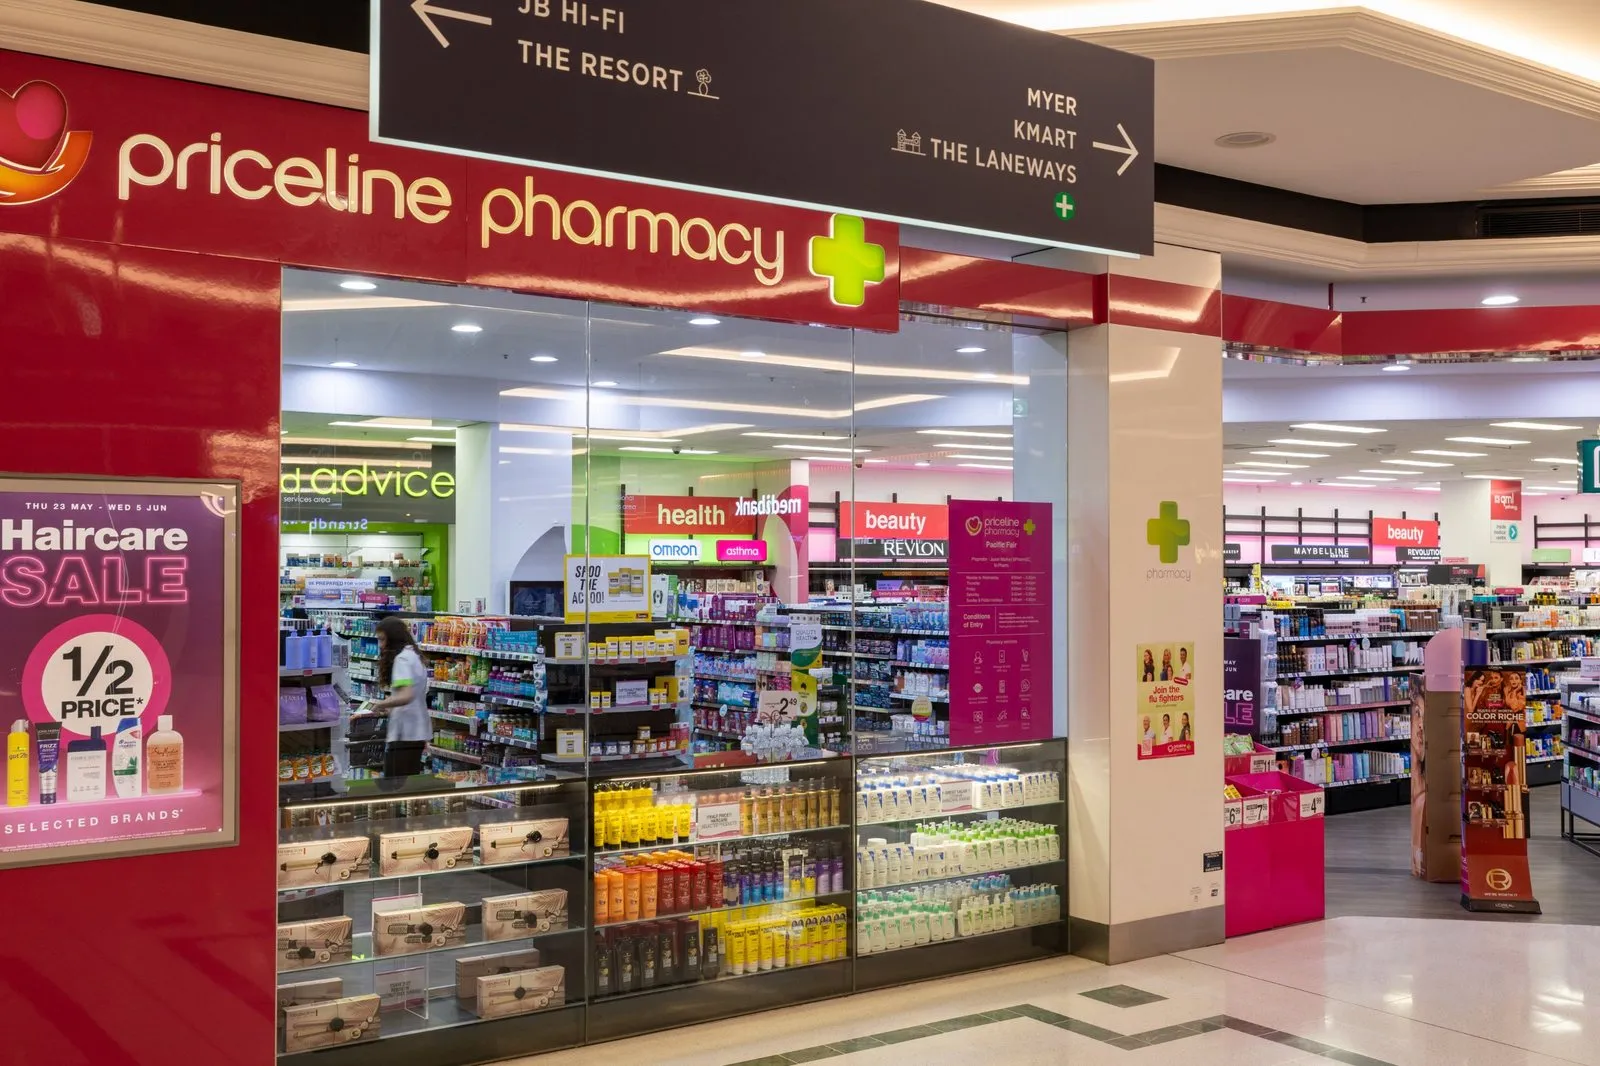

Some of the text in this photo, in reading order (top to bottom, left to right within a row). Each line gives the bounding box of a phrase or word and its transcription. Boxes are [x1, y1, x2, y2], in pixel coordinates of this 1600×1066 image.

[518, 0, 625, 34] JB HI-FI
[517, 39, 684, 92] THE RESORT
[1027, 88, 1077, 116] MYER
[1014, 119, 1077, 150] KMART
[930, 137, 1077, 184] THE LANEWAYS
[118, 132, 785, 286] priceline pharmacy
[310, 460, 456, 498] advice
[25, 502, 48, 510] THU
[71, 503, 94, 511] MAY
[108, 503, 131, 511] WED
[283, 495, 331, 504] services area
[657, 504, 725, 526] health
[865, 510, 926, 535] beauty
[984, 516, 1020, 528] priceline
[1, 518, 189, 551] Haircare
[984, 527, 1020, 538] pharmacy
[1387, 524, 1424, 544] beauty
[652, 545, 698, 557] OMRON
[726, 546, 760, 556] asthma
[884, 542, 945, 557] REVLON
[1006, 541, 1018, 549] Fair
[1293, 547, 1350, 555] MAYBELLINE
[0, 555, 189, 607] SALE
[1146, 568, 1191, 581] pharmacy
[572, 591, 605, 604] ACOO!
[62, 645, 134, 696] 1/2
[1152, 685, 1180, 694] Join the
[779, 697, 798, 715] 2 49
[1148, 693, 1185, 704] flu fighters
[1466, 712, 1524, 721] COLOR RICHE
[1257, 804, 1263, 820] 7
[1310, 797, 1317, 813] 4
[1229, 807, 1236, 824] 6
[4, 817, 99, 834] SELECTED
